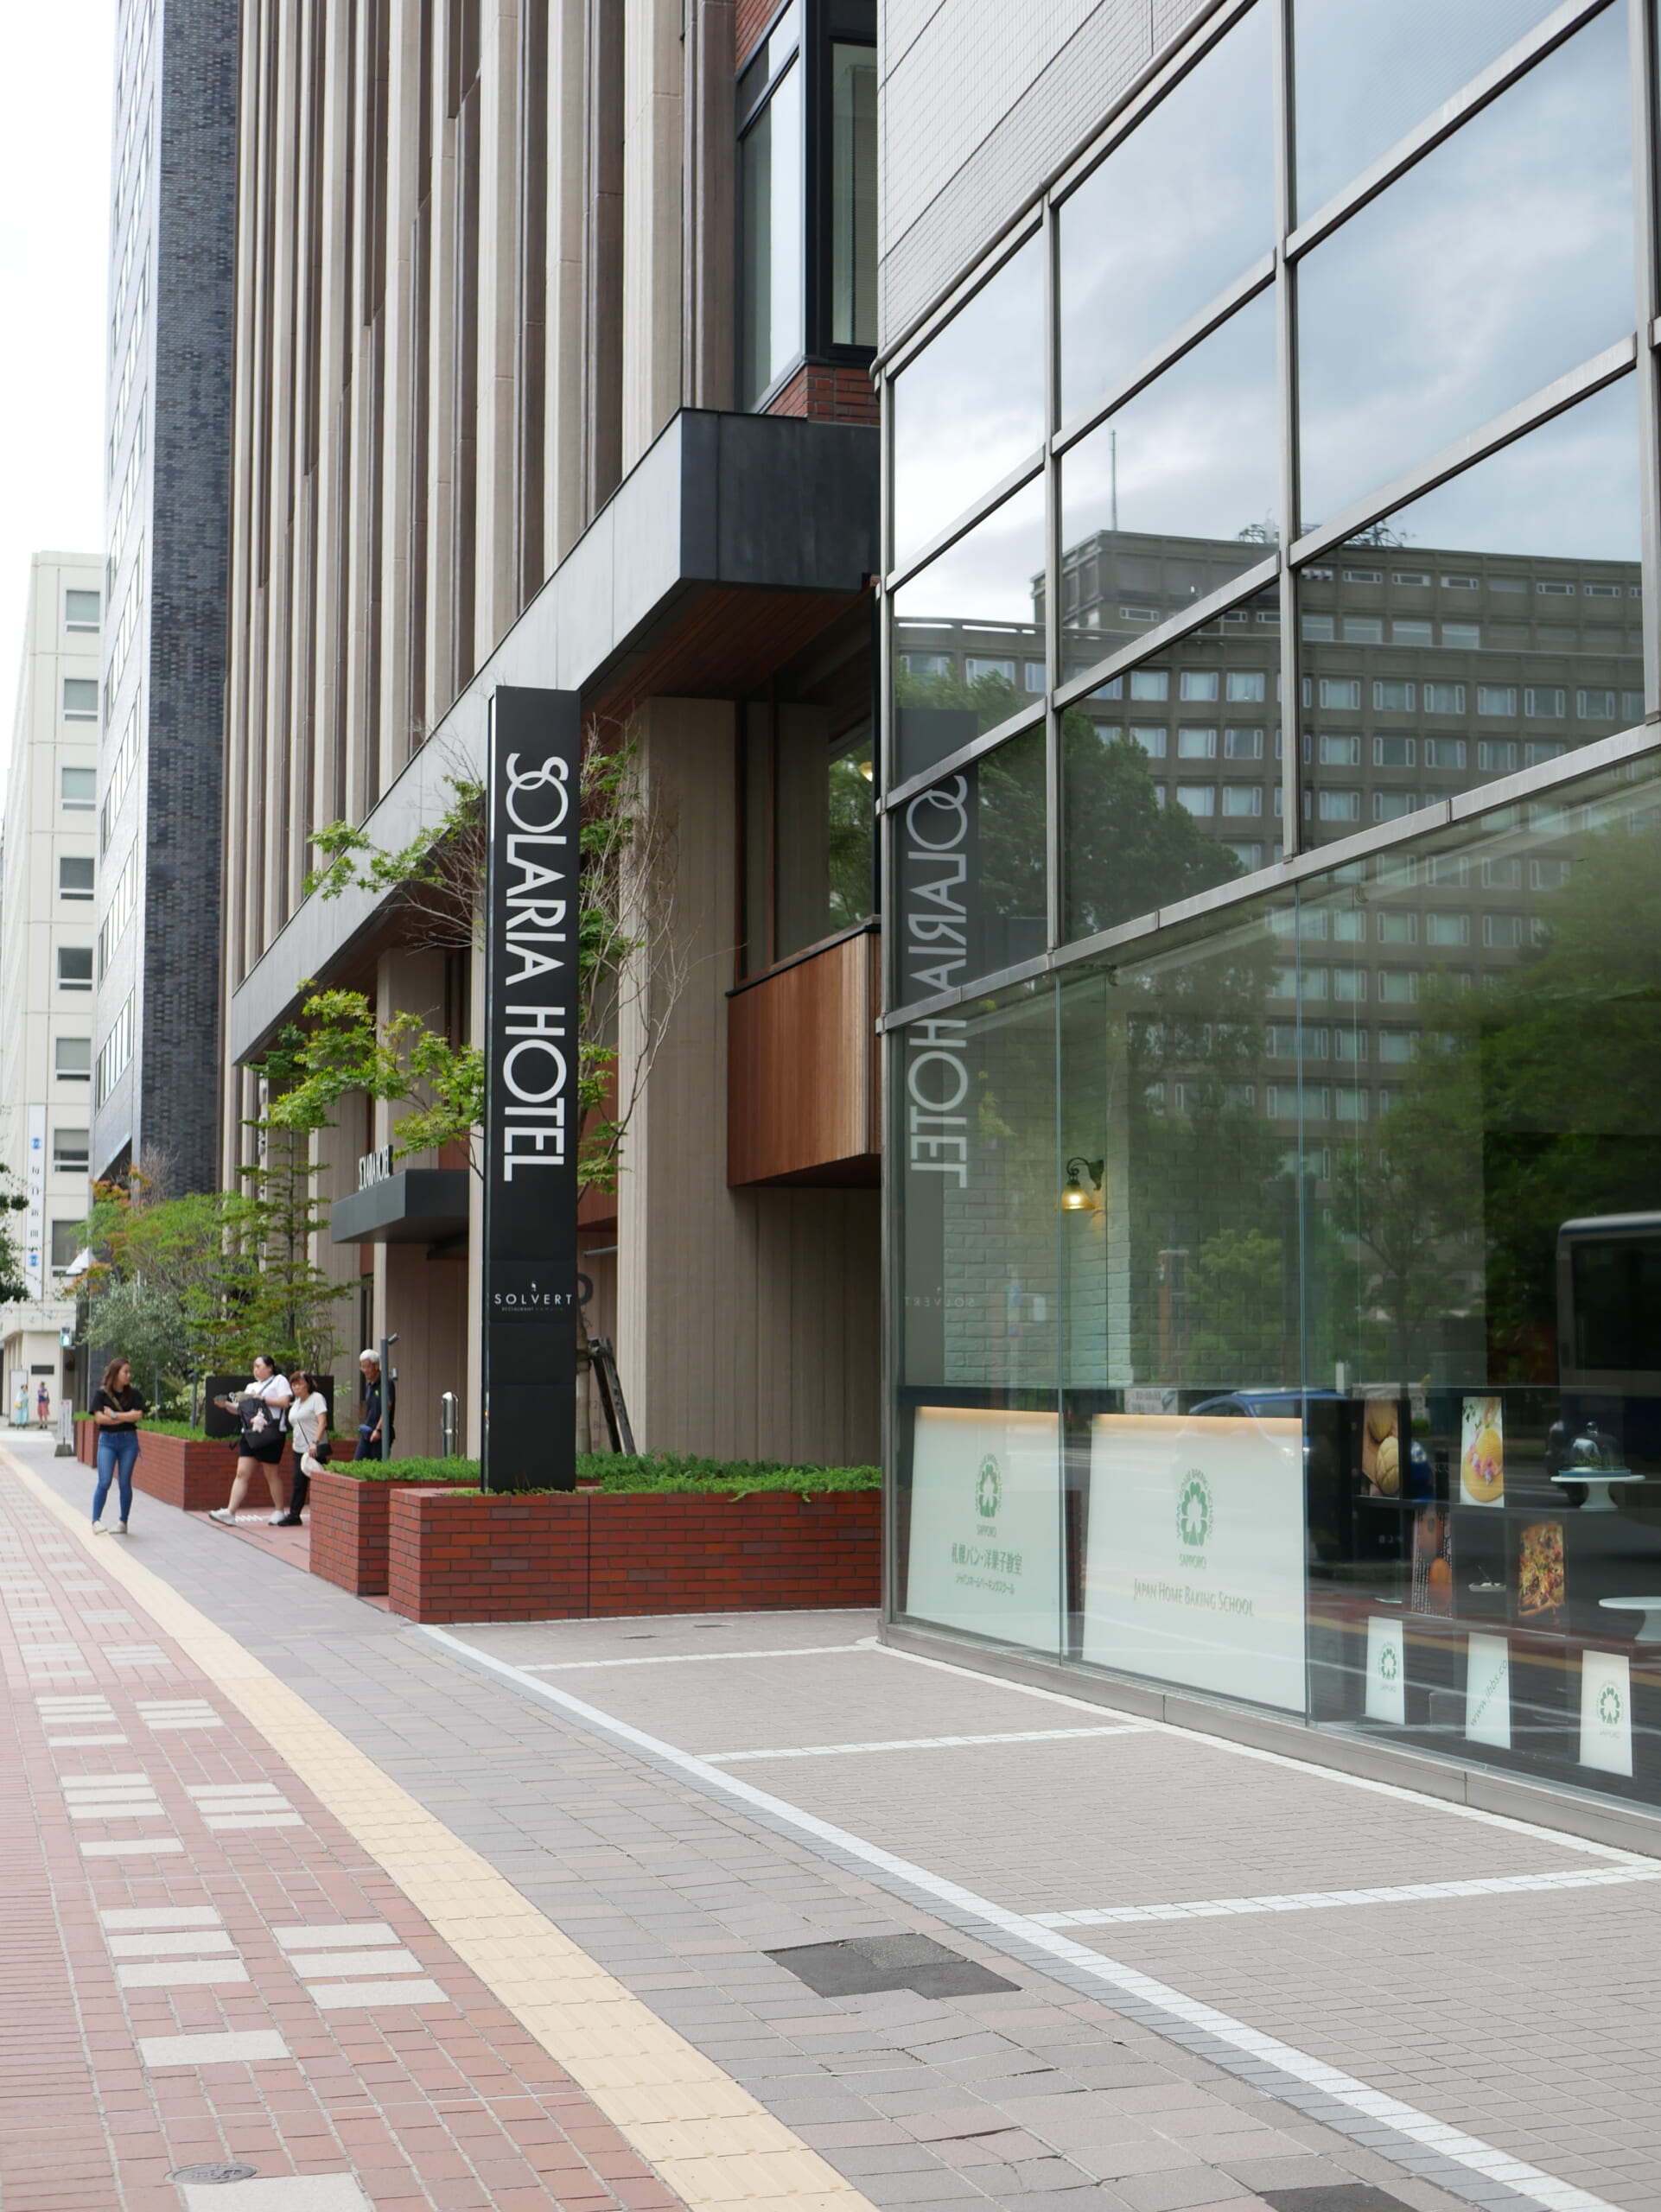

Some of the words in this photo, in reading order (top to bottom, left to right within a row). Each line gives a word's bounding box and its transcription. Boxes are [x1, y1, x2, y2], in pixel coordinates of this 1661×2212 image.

[506, 753, 569, 986] SOLARIA
[503, 1006, 567, 1181] HOTEL
[494, 1294, 572, 1305] SOLVERT
